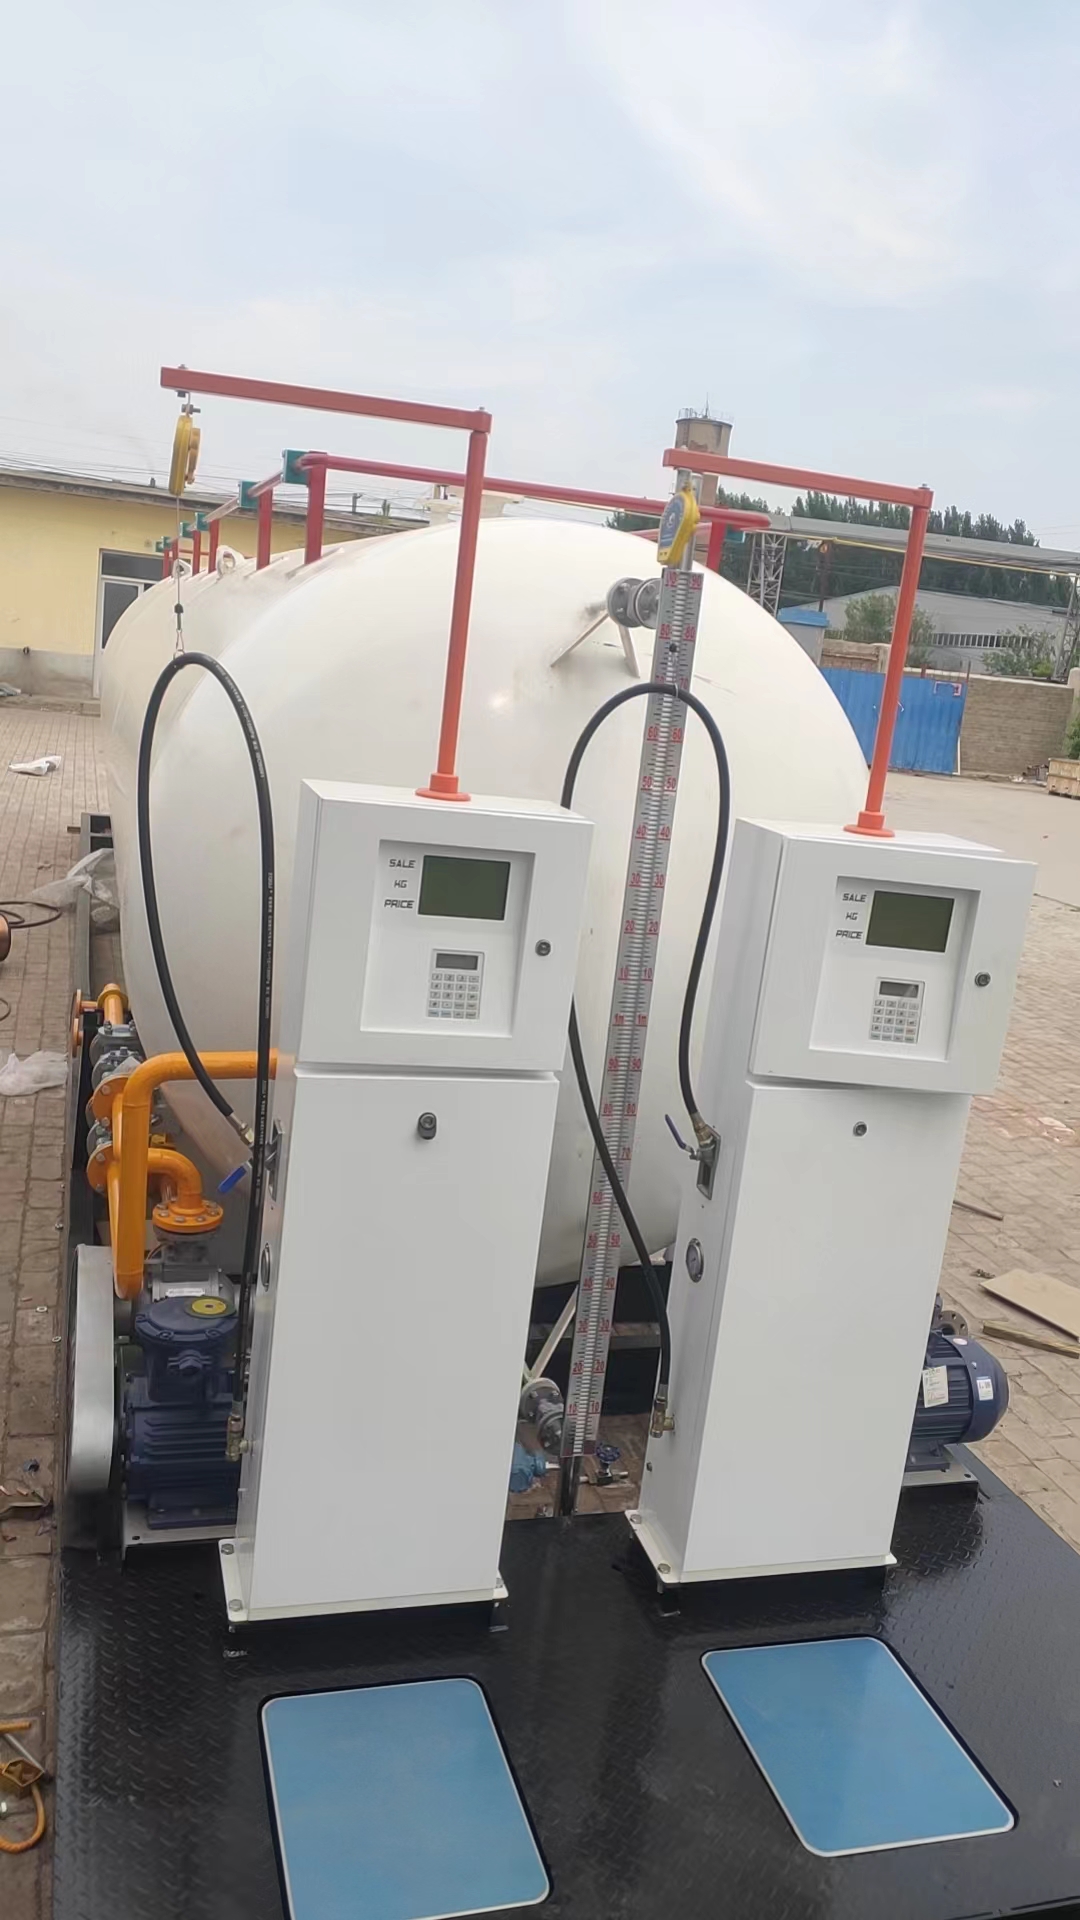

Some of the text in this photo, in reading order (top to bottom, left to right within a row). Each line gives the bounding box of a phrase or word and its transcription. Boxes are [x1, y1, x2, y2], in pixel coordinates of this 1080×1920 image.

[685, 624, 696, 639] 80
[648, 726, 682, 740] 60 60
[642, 776, 676, 789] 50 50
[636, 824, 670, 838] 40 40
[389, 858, 416, 868] SALE
[394, 880, 408, 888] KG
[630, 872, 664, 886] 30 30
[842, 892, 867, 902] SALE
[384, 899, 414, 908] PRICE
[846, 912, 858, 920] KG
[624, 920, 658, 932] 20 20
[836, 930, 863, 940] PRICE
[644, 968, 652, 979] 10
[573, 1360, 605, 1373] 20 20
